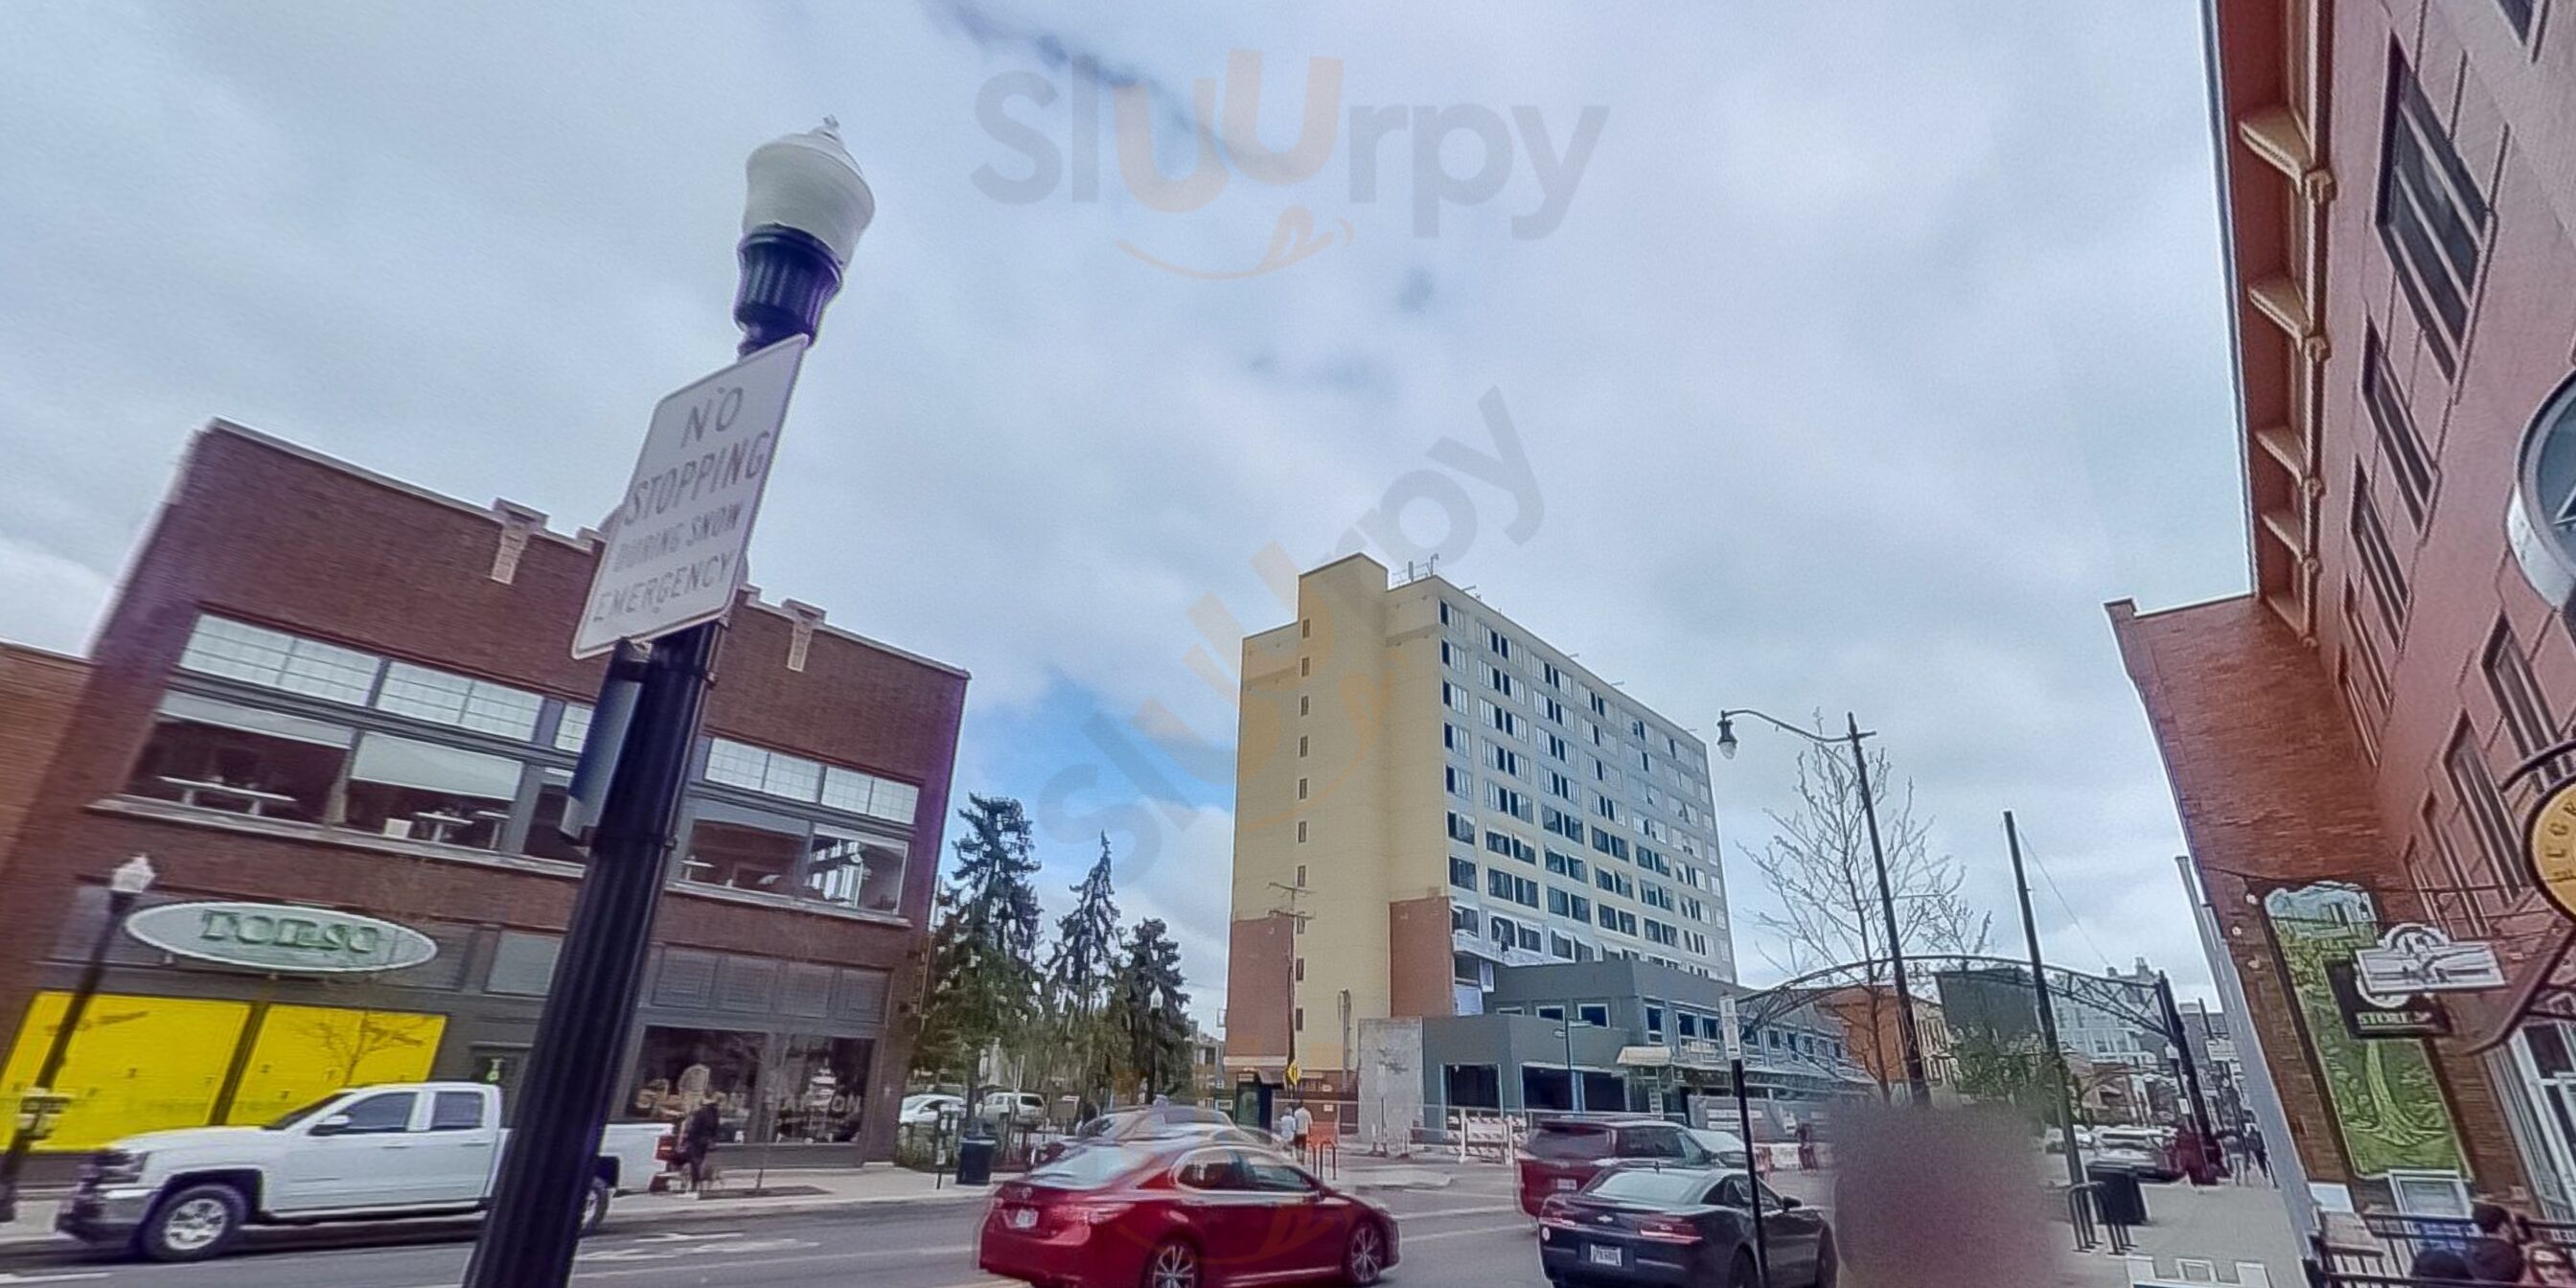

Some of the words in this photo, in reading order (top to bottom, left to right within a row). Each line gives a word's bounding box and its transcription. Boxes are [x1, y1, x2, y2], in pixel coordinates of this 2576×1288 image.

[679, 387, 744, 449] NO
[625, 431, 770, 525] STOPPING
[687, 501, 743, 547] SNOW
[592, 550, 738, 623] EMERGENCY
